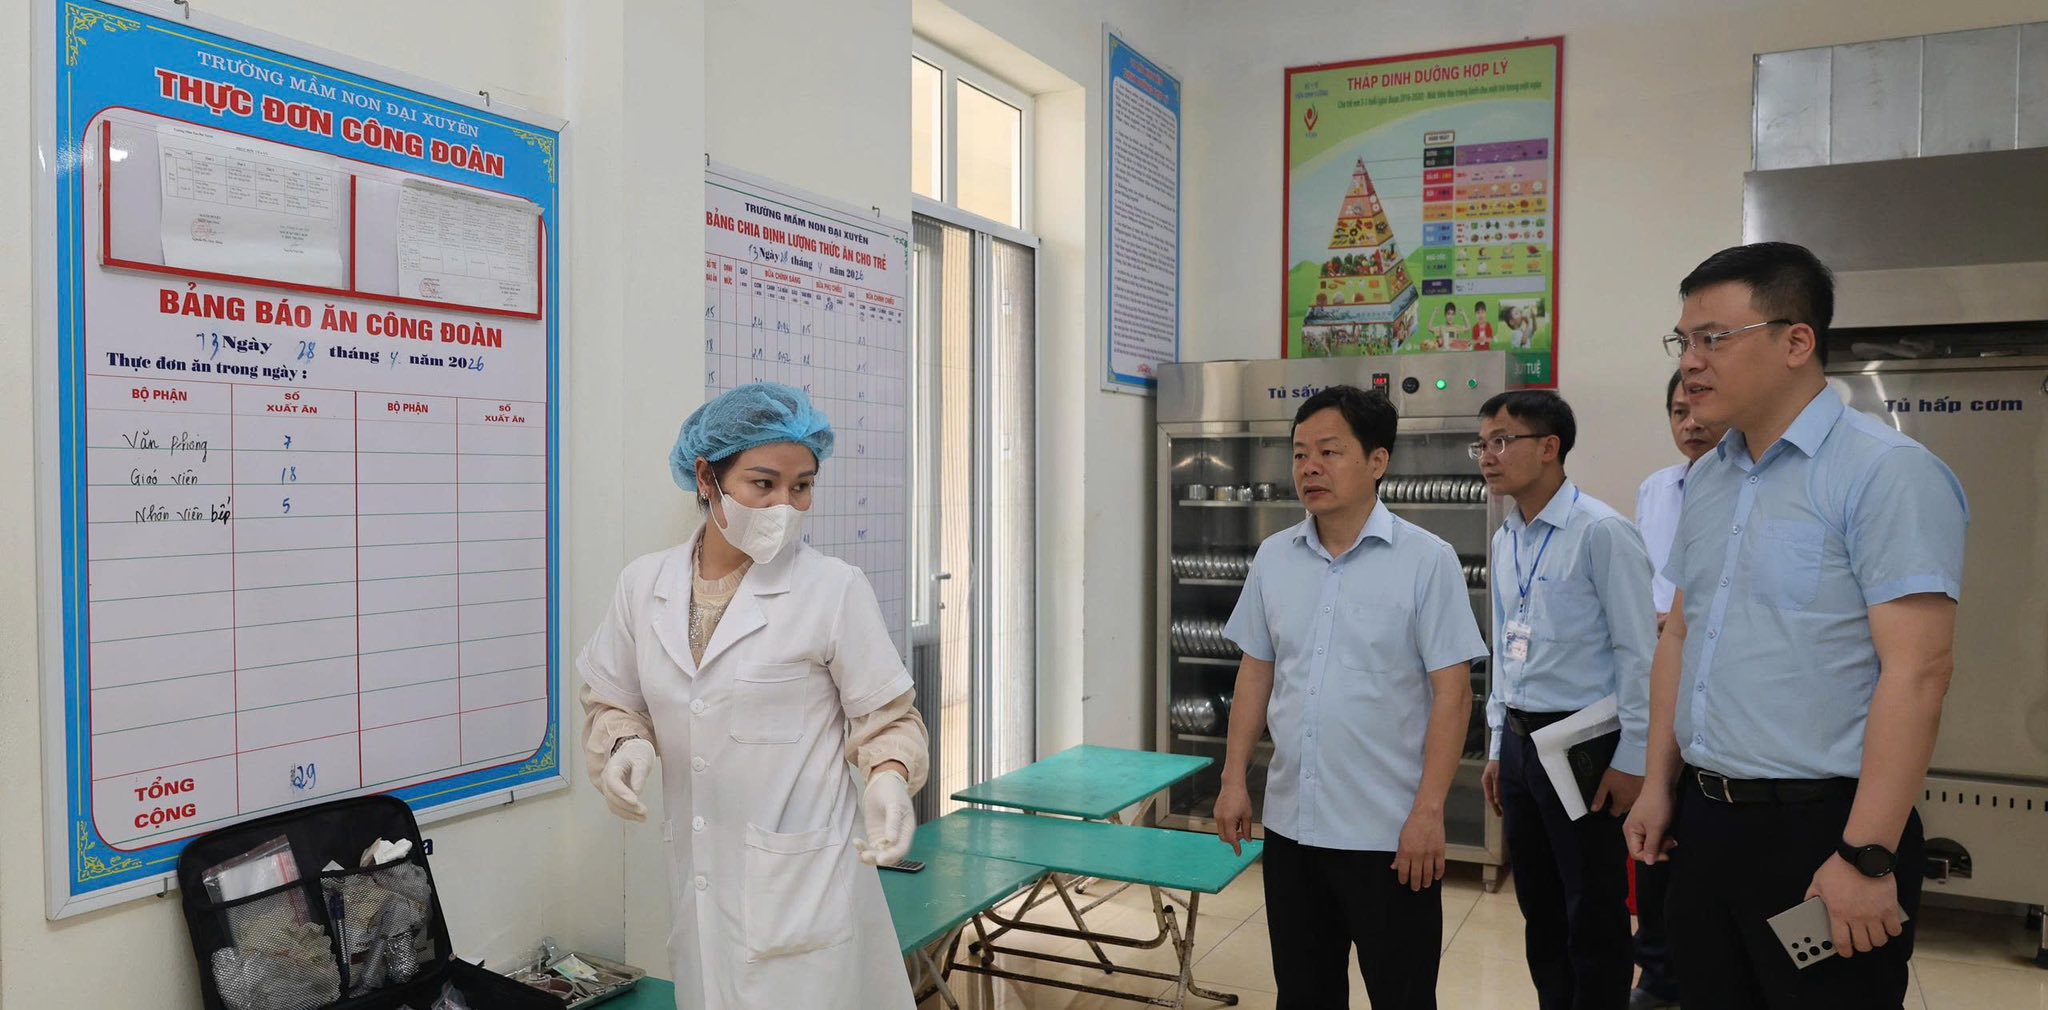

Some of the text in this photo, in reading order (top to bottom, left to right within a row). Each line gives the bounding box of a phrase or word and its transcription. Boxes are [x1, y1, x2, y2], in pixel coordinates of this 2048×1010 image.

[1347, 57, 1508, 91] THÁP DINH DƯỠNG HỢP LÝ
[197, 51, 480, 138] TRƯỜNG MẦM NON ĐẠI XUYÊN
[155, 67, 504, 179] THỰC ĐƠN CÔNG ĐOÀN
[745, 202, 781, 220] TRƯỜNG
[808, 220, 826, 233] NON
[828, 226, 842, 238] ĐẠI
[844, 231, 869, 245] XUYÊN
[706, 207, 887, 271] BẢNG CHIA ĐỊNH LƯỢNG THỨC ĂN CHO TRẺ
[760, 247, 779, 263] Ngày
[791, 255, 813, 270] tháng
[829, 265, 845, 277] năm
[160, 282, 502, 349] BẢNG BÁO ĂN CÔNG ĐOÀN
[222, 335, 273, 354] Ngày
[297, 340, 316, 360] 28
[329, 346, 380, 364] tháng
[409, 354, 444, 368] năm
[448, 355, 485, 372] 2026
[106, 352, 151, 372] Thực
[155, 355, 187, 371] đơn
[191, 359, 211, 373] ăn
[216, 362, 258, 380] trong
[262, 363, 299, 382] ngày
[132, 386, 187, 404] BỘ PHẬN
[284, 391, 300, 401] SỐ
[1268, 386, 1286, 399] Tủ
[266, 403, 318, 414] XUẤT ĂN
[387, 402, 429, 415] BỘ PHẬN
[499, 404, 511, 412] SỐ
[1885, 396, 2023, 414] Tủ hấp cơm
[484, 413, 525, 423] XUẤT ĂN
[122, 430, 160, 450] Văn
[283, 435, 292, 449] 7
[281, 465, 297, 485] 18
[282, 497, 291, 514] 5
[134, 776, 195, 802] TỔNG
[134, 802, 196, 830] CỘNG
